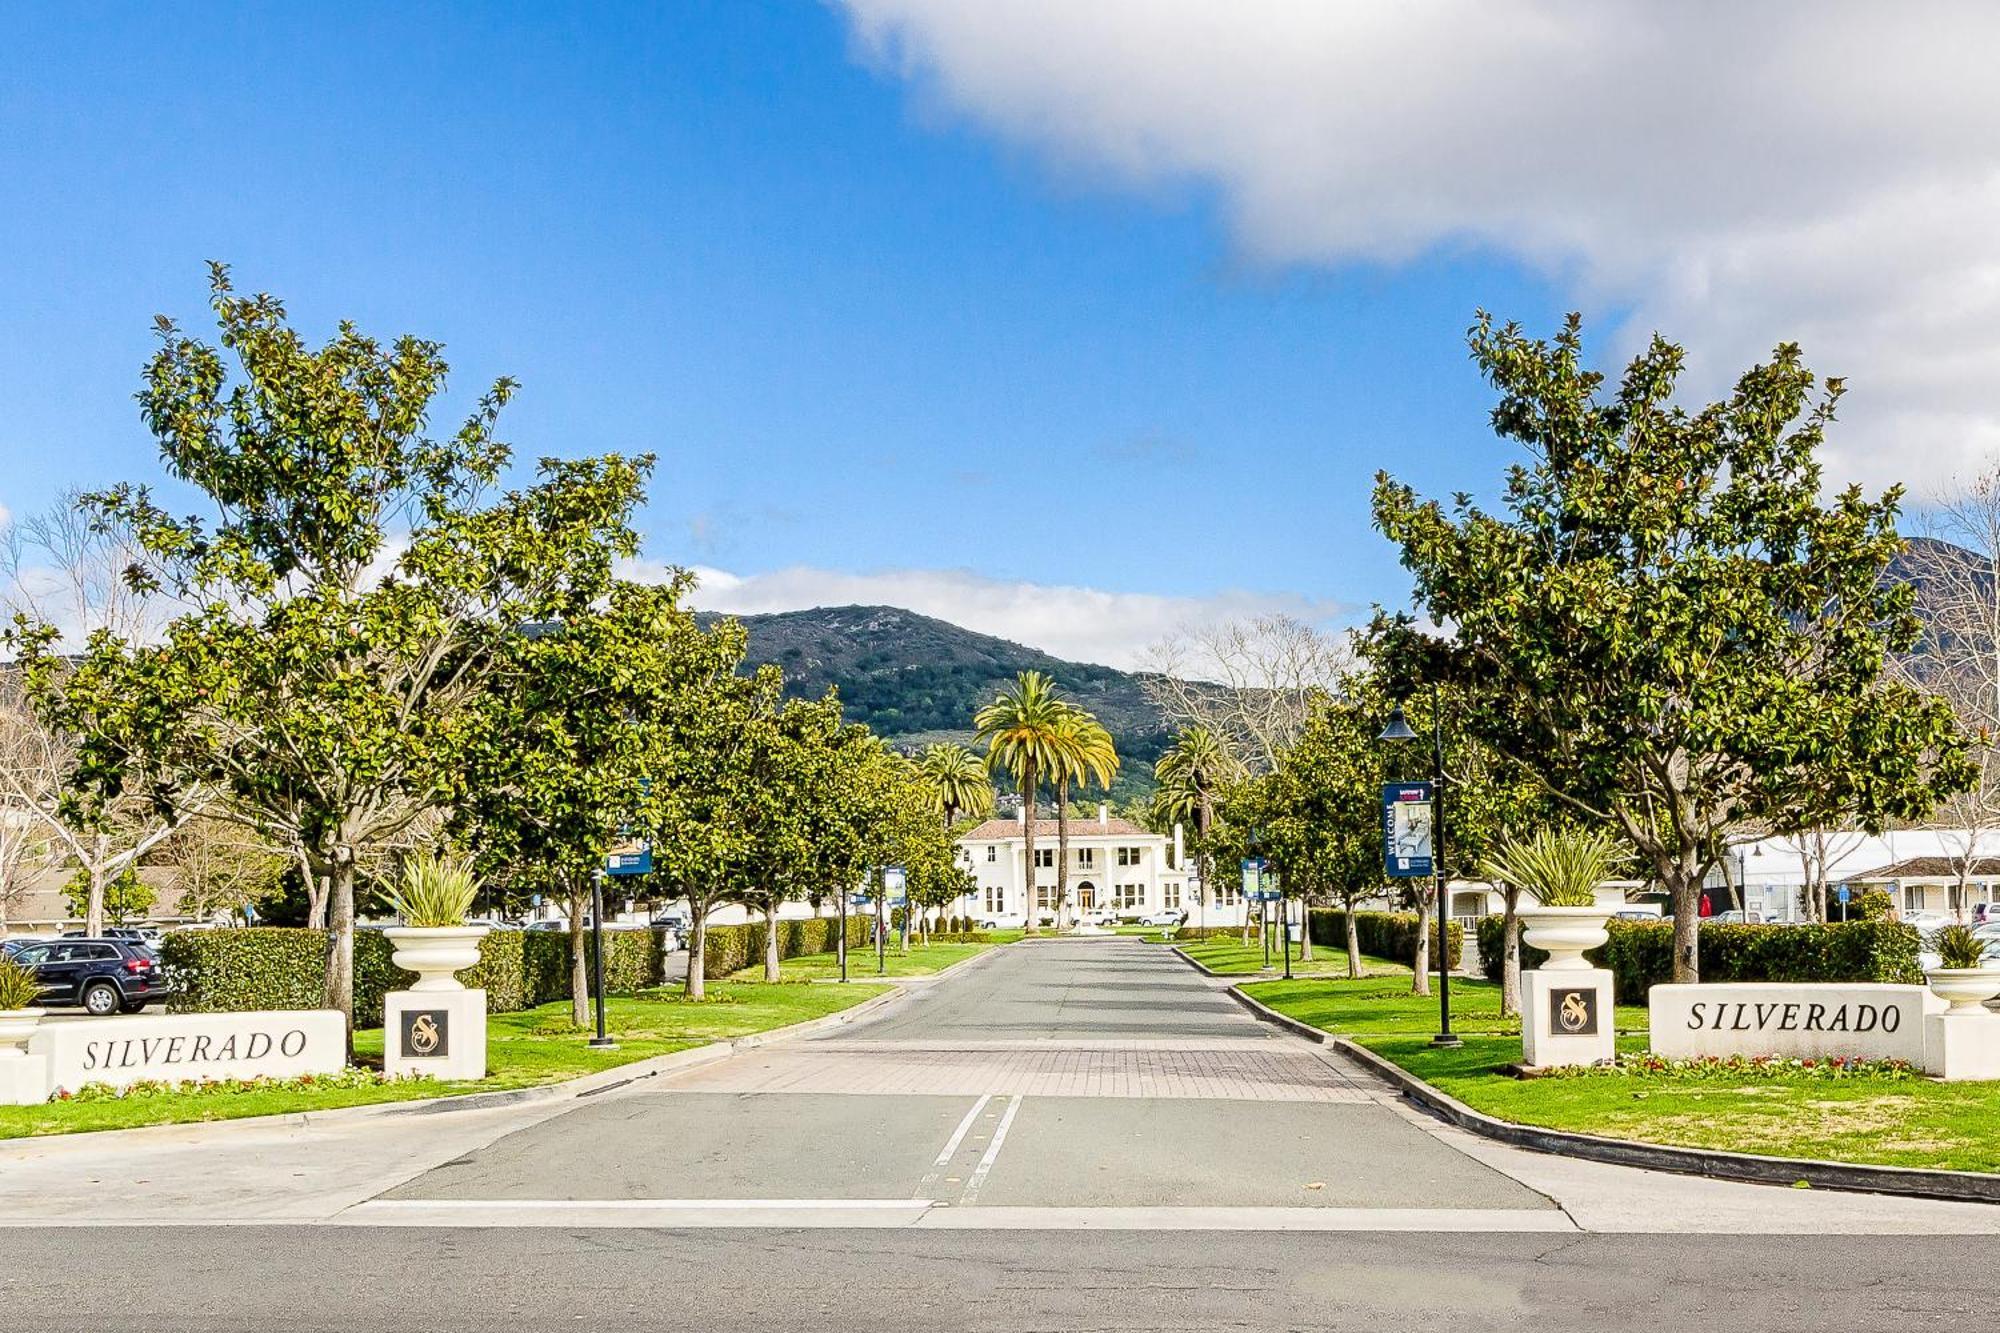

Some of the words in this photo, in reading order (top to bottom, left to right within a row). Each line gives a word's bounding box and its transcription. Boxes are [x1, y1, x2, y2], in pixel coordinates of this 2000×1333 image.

[1386, 804, 1396, 856] WELCOME
[1687, 1003, 1901, 1033] SILVERADO
[83, 1029, 307, 1070] SILVERADO
